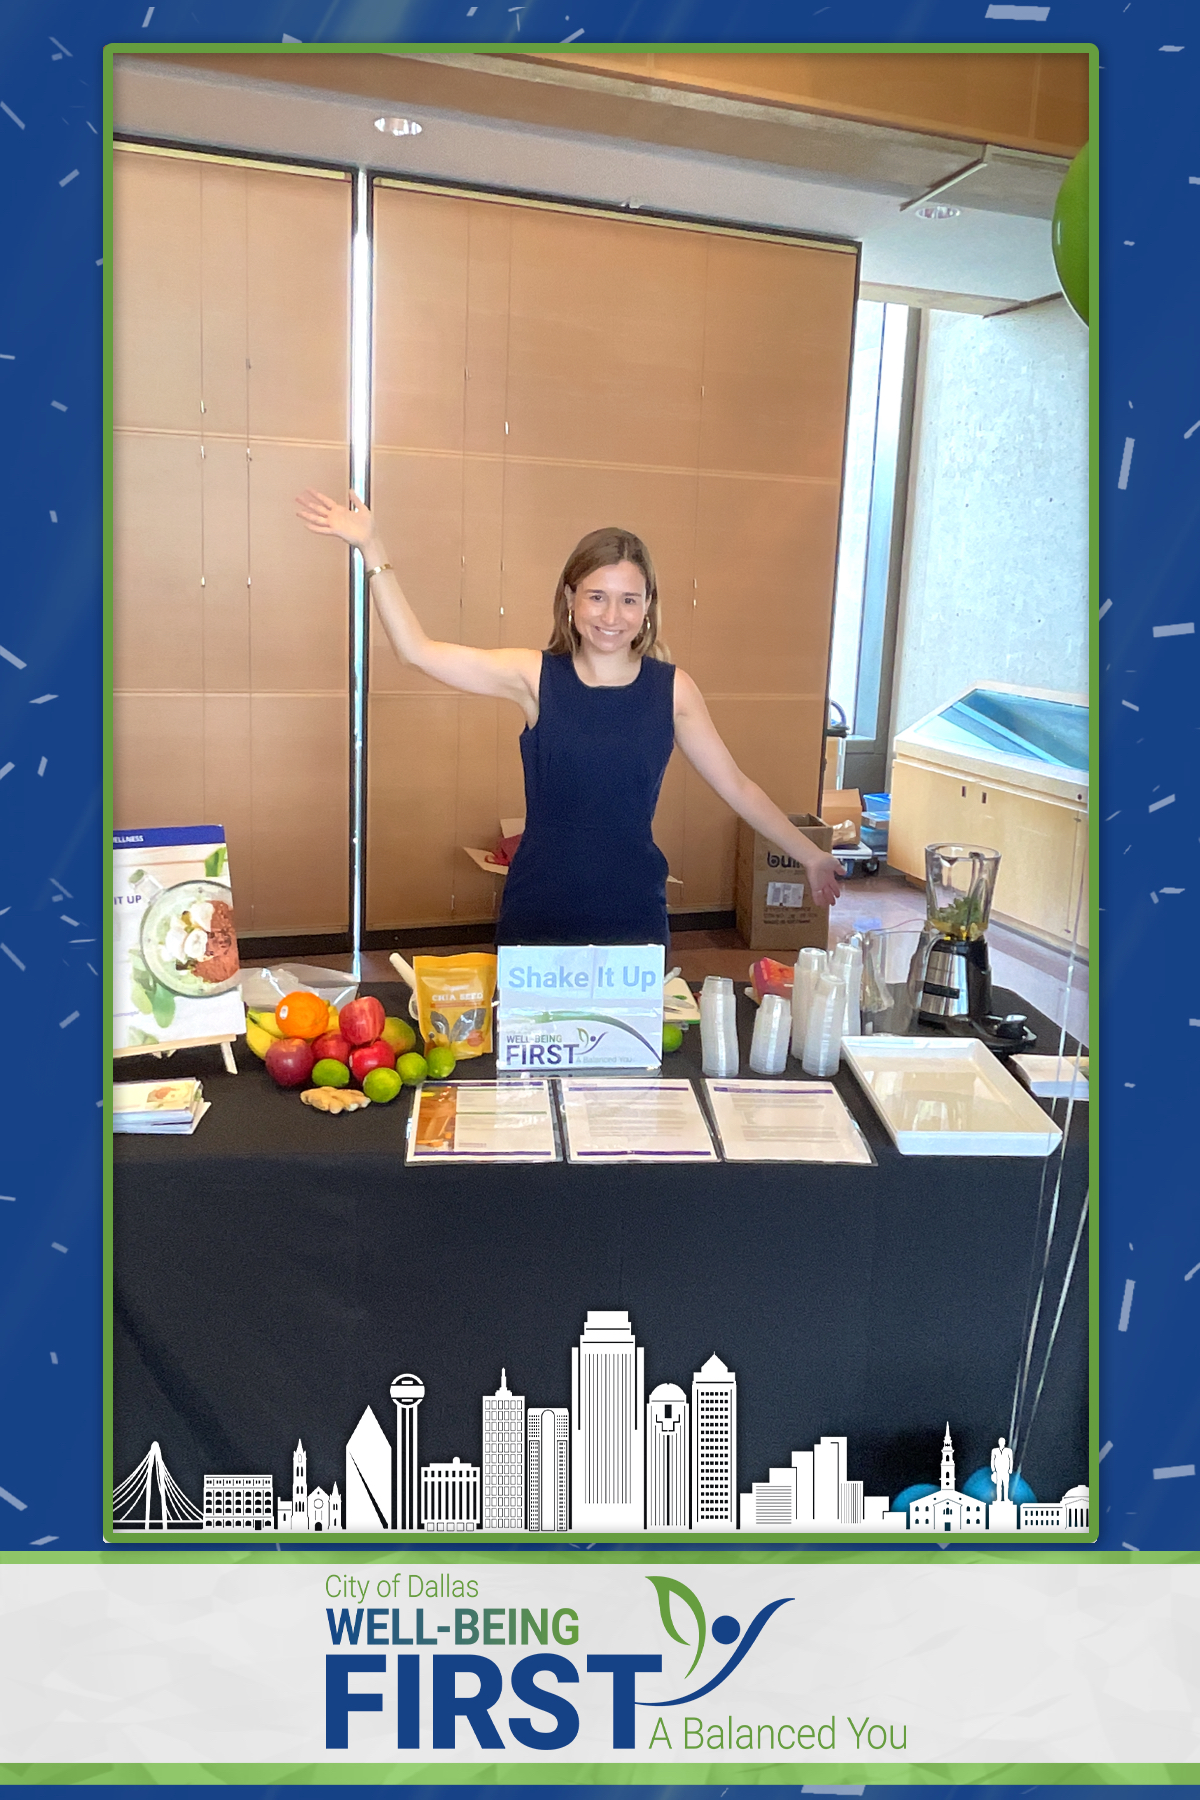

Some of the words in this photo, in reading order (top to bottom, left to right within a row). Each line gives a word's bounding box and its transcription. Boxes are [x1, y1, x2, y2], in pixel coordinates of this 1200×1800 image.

[114, 896, 123, 905] IT
[126, 895, 142, 904] UP
[508, 966, 589, 989] Shake
[597, 966, 615, 988] It
[622, 965, 657, 992] Up
[431, 994, 456, 1002] CHIA
[460, 992, 484, 1001] SEED
[506, 1034, 563, 1044] WELL-BEING
[506, 1043, 580, 1066] FIRST
